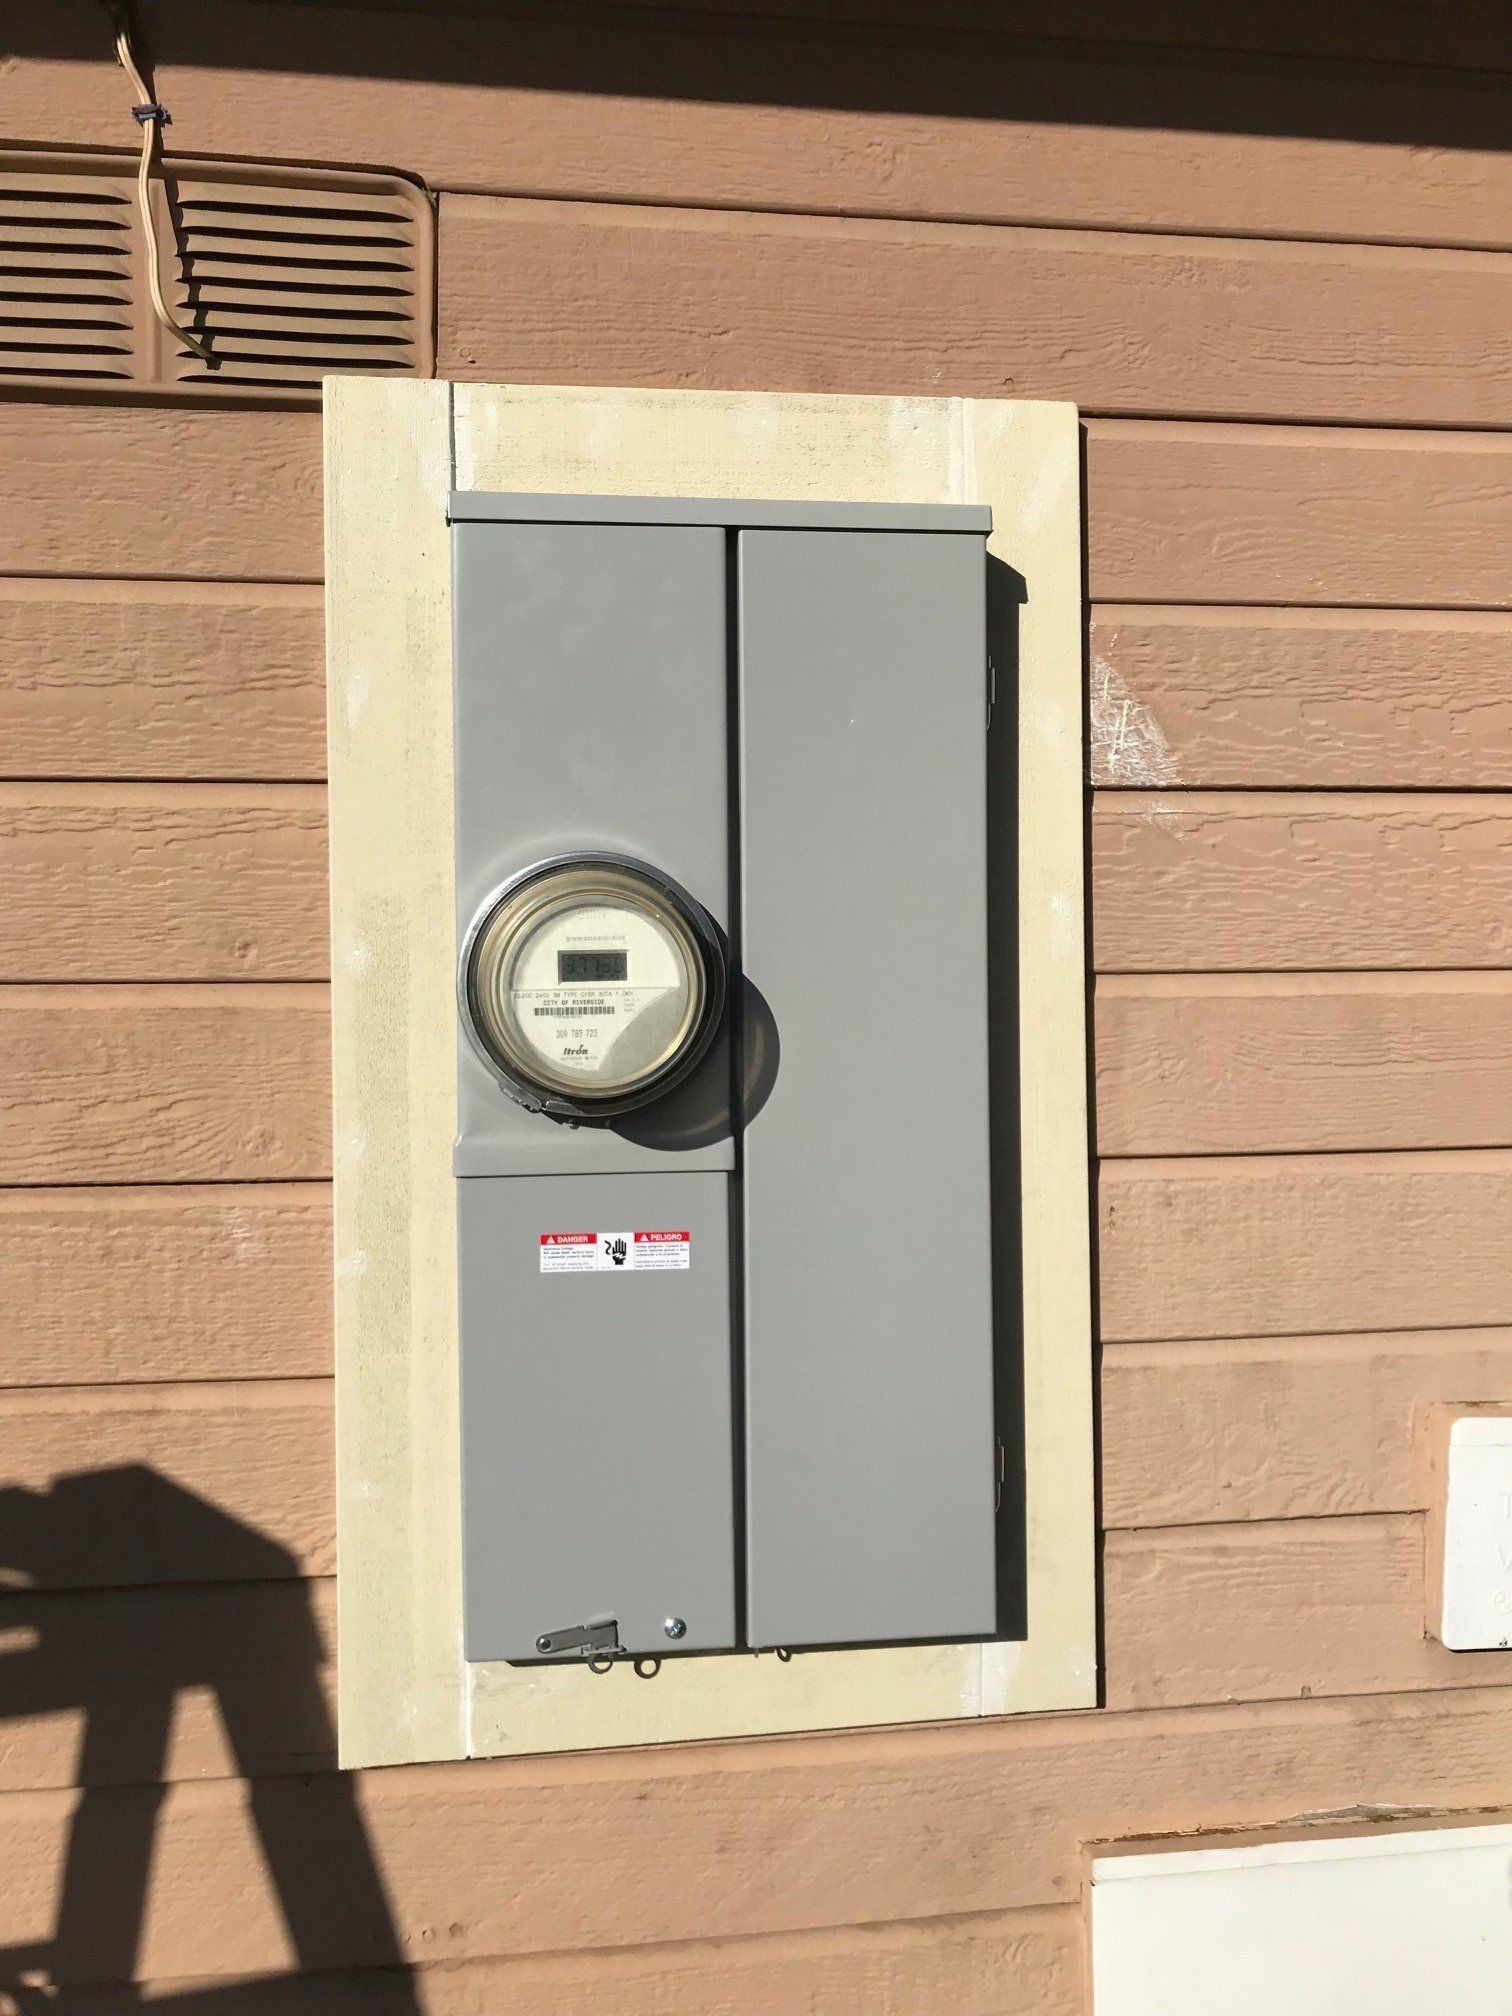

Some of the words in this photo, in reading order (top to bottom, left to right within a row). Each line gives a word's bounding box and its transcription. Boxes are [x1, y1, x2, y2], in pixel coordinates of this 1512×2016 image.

[586, 1029, 598, 1038] 723
[557, 1235, 589, 1243] DANGER
[650, 1233, 683, 1241] PELIGRO
